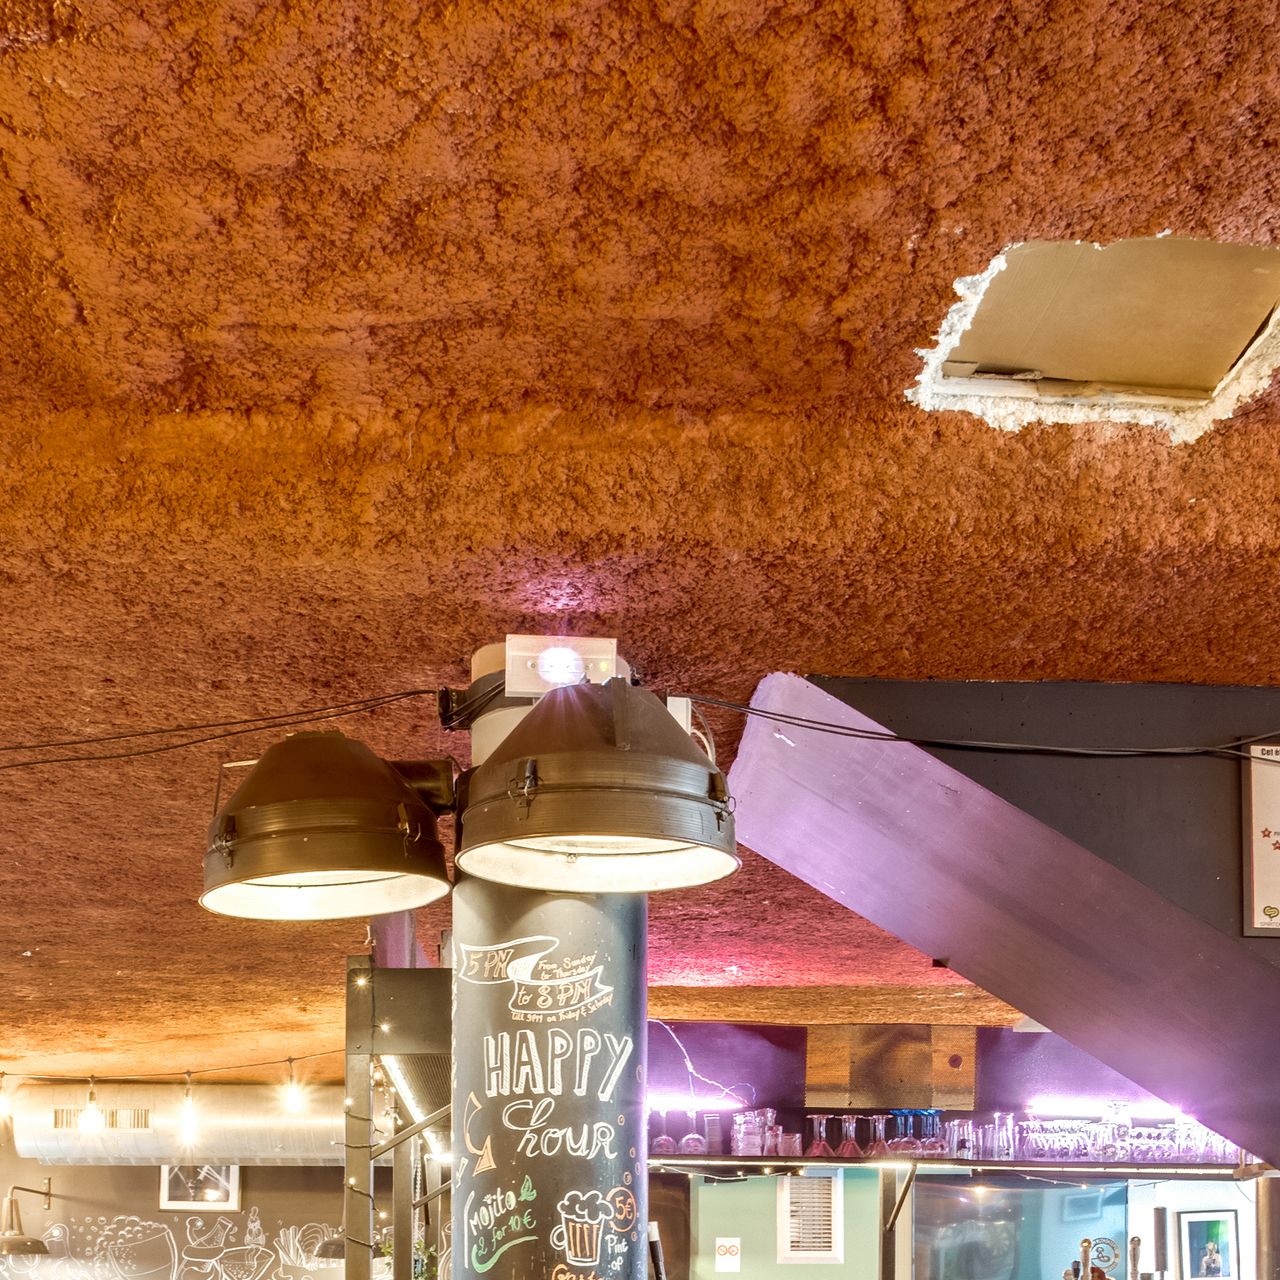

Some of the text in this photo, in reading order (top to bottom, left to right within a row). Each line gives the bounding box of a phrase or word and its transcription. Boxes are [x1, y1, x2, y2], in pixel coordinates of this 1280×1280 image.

[1261, 748, 1274, 756] Cet
[467, 949, 514, 978] 5 PM
[538, 951, 598, 971] From Sunday
[553, 965, 591, 979] Thursday
[517, 978, 593, 1009] to 8 PM
[484, 1028, 634, 1102] HAPPY
[615, 1196, 633, 1221] 5€
[477, 1208, 537, 1257] 2 for 10 €
[604, 1234, 629, 1254] Pint
